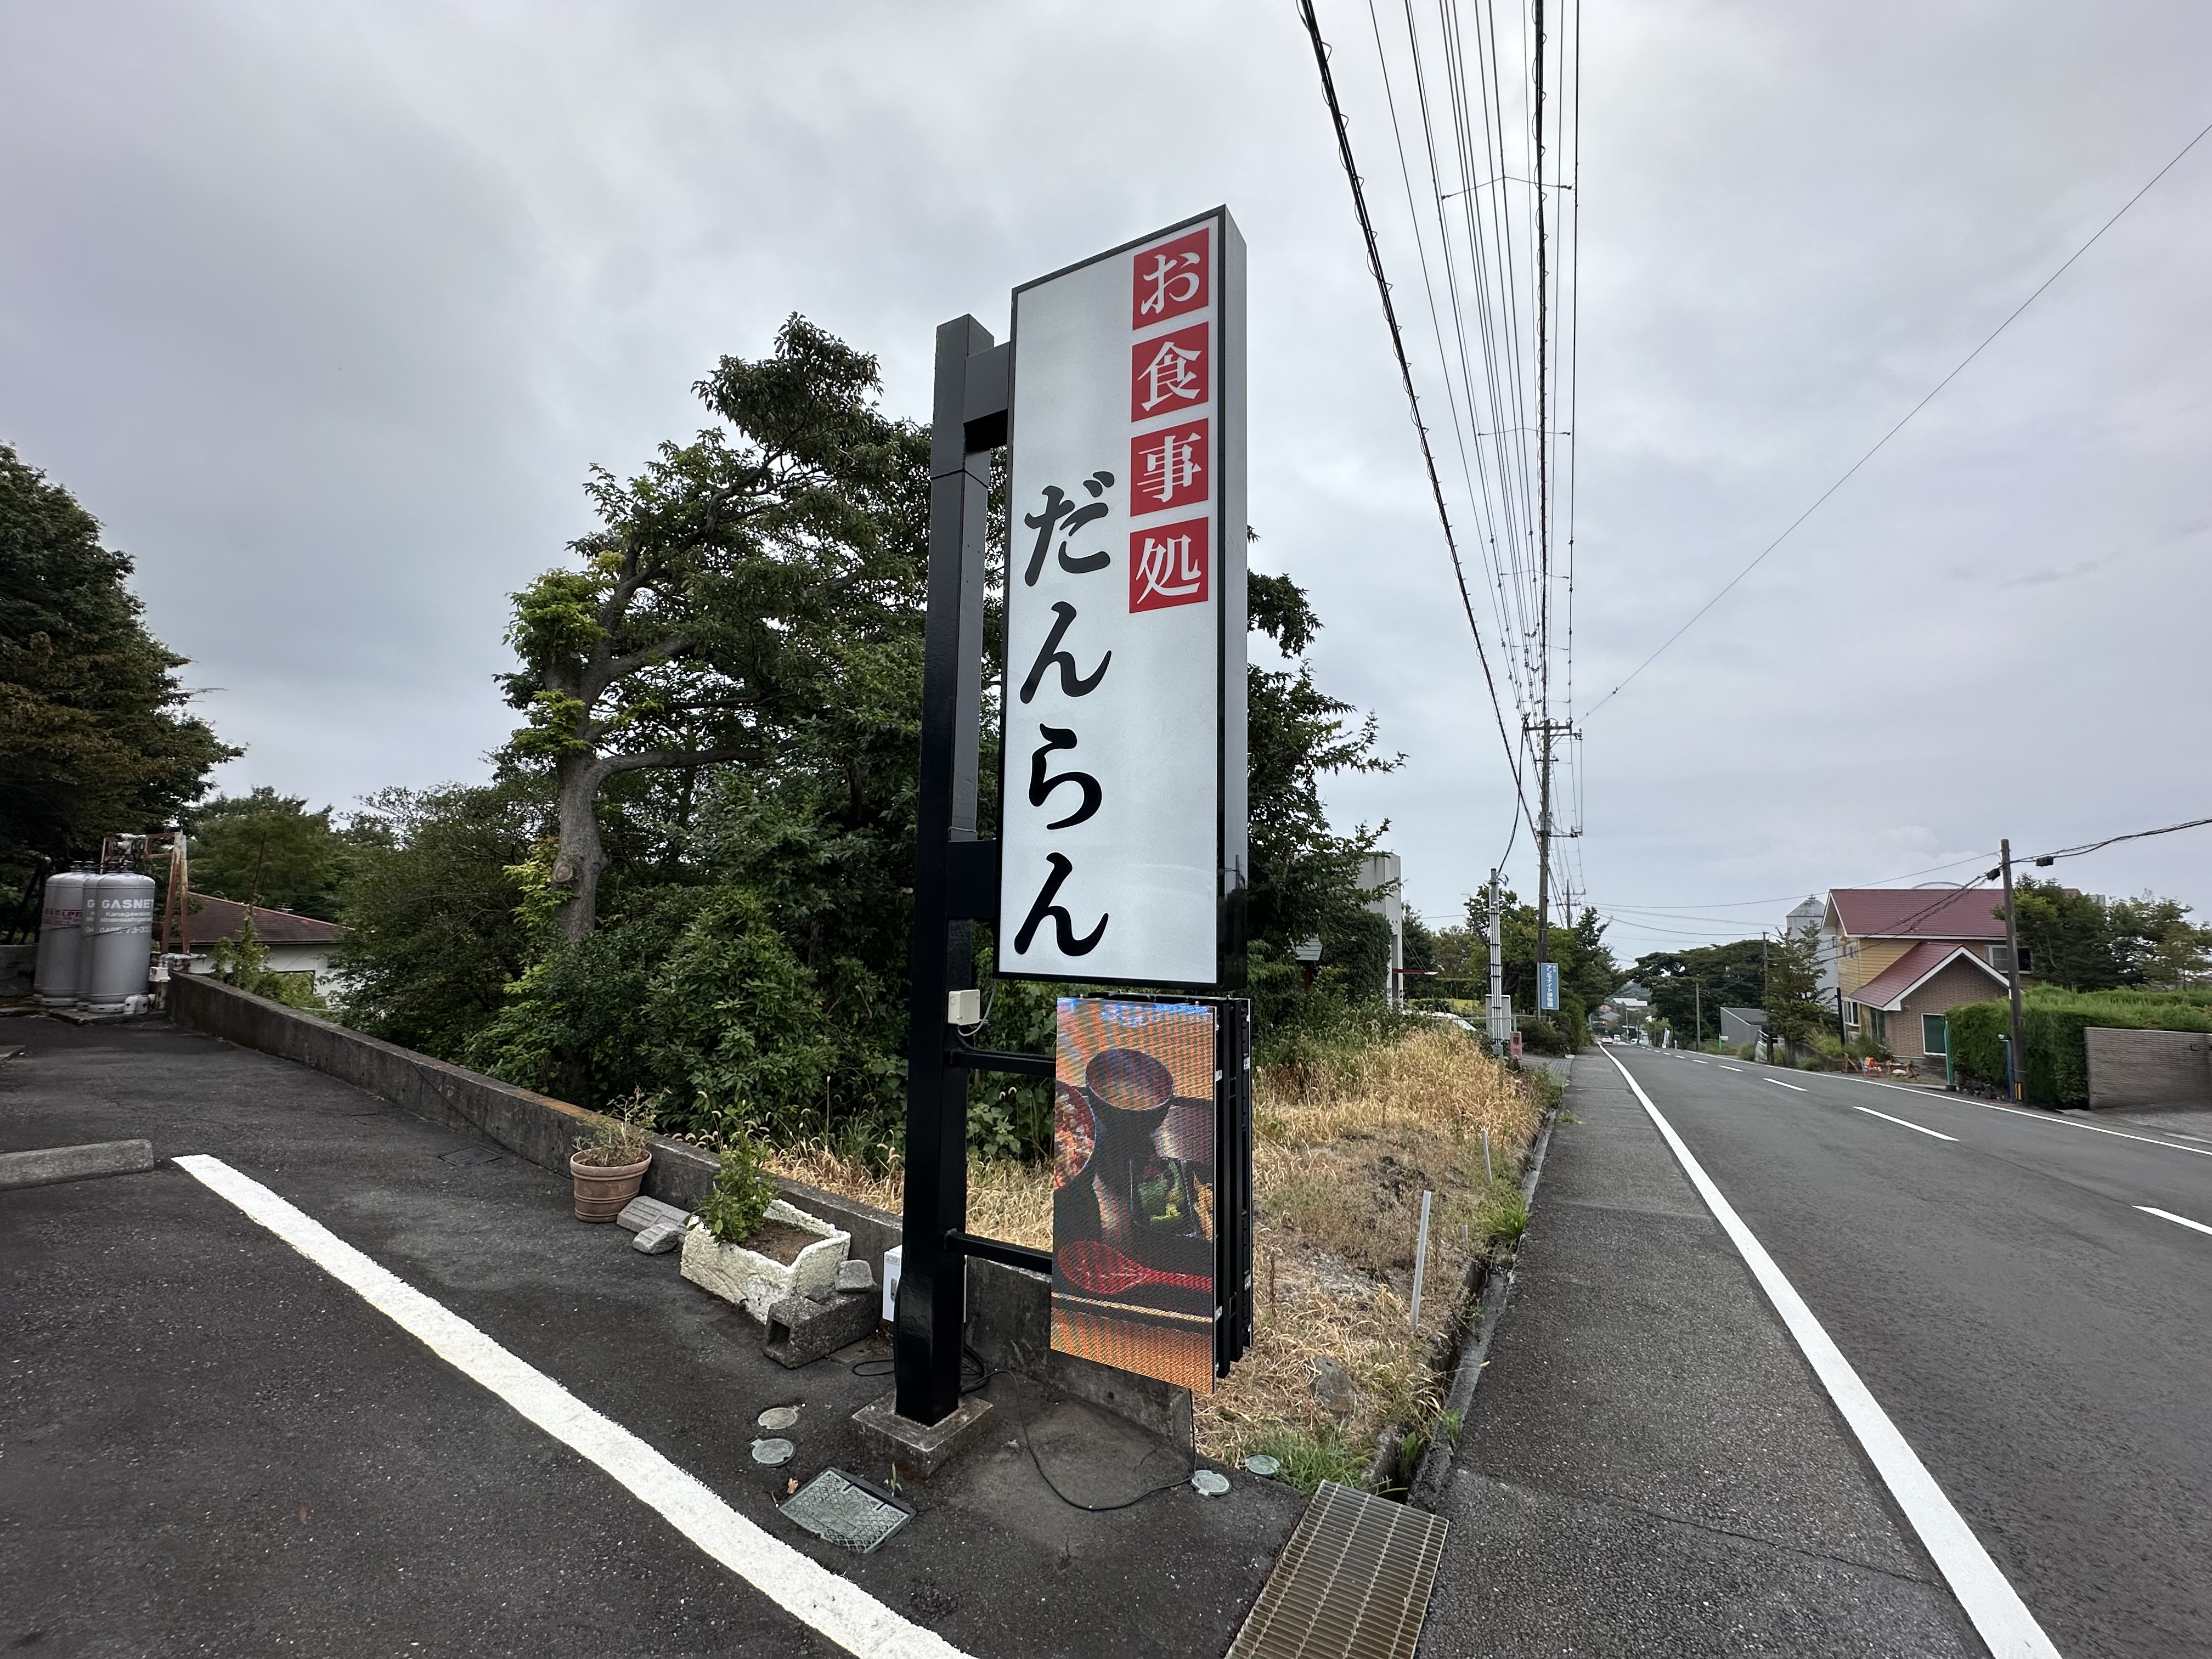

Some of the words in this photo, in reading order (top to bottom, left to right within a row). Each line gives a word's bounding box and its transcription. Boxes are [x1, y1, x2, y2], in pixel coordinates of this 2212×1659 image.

[1136, 252, 1202, 605] お食事処
[1014, 471, 1115, 956] だんらん
